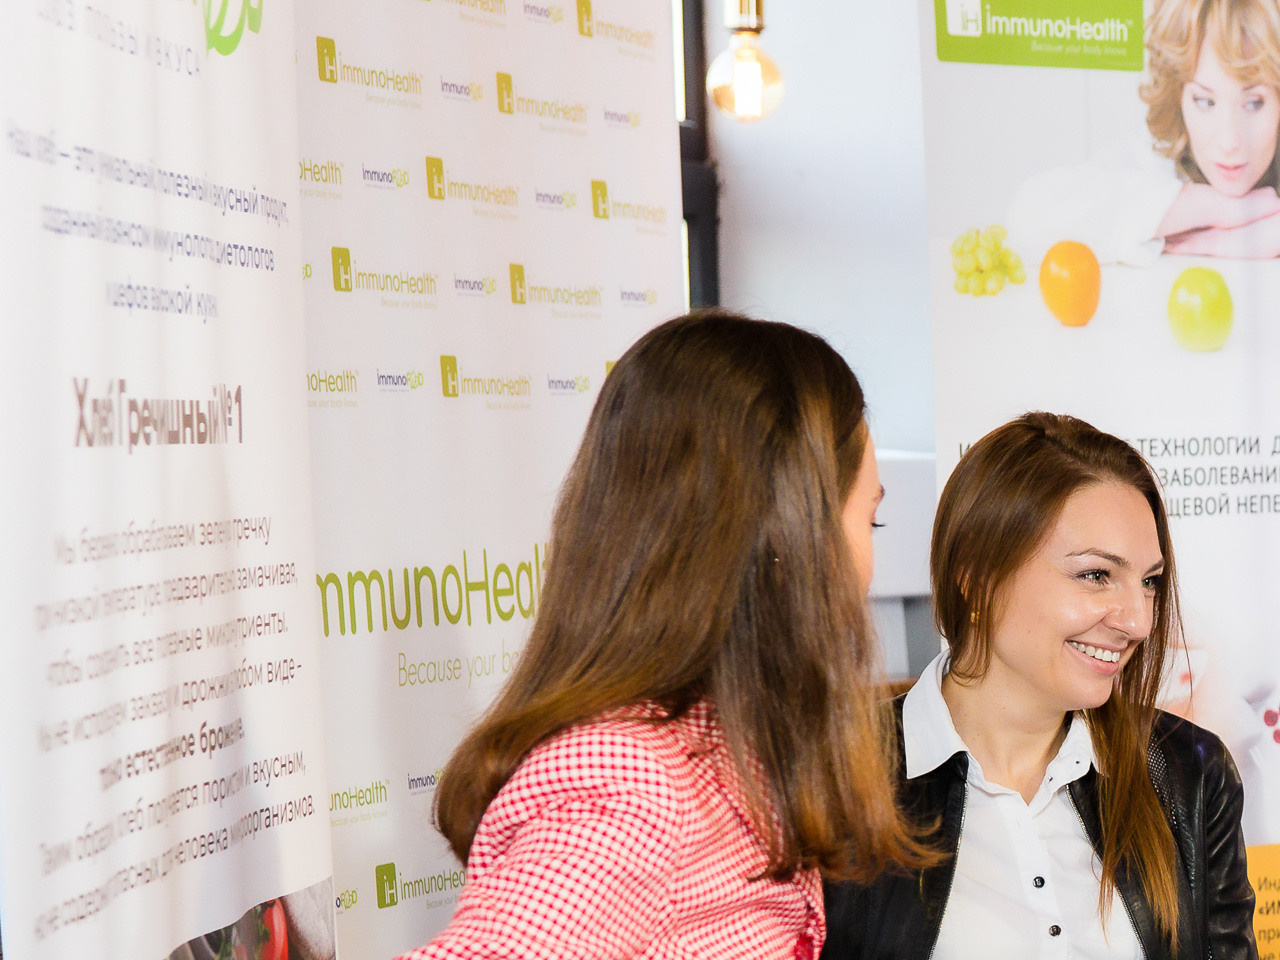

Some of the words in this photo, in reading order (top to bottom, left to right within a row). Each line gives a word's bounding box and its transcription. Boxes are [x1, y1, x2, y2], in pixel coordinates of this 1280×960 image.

[354, 260, 437, 295] immunoHealth
[1137, 436, 1260, 457] ТЕХНОЛОГИИ
[1167, 492, 1230, 518] ЩЕВОЙ
[398, 652, 463, 687] Because
[466, 653, 500, 689] your
[400, 869, 467, 900] immunoHea
